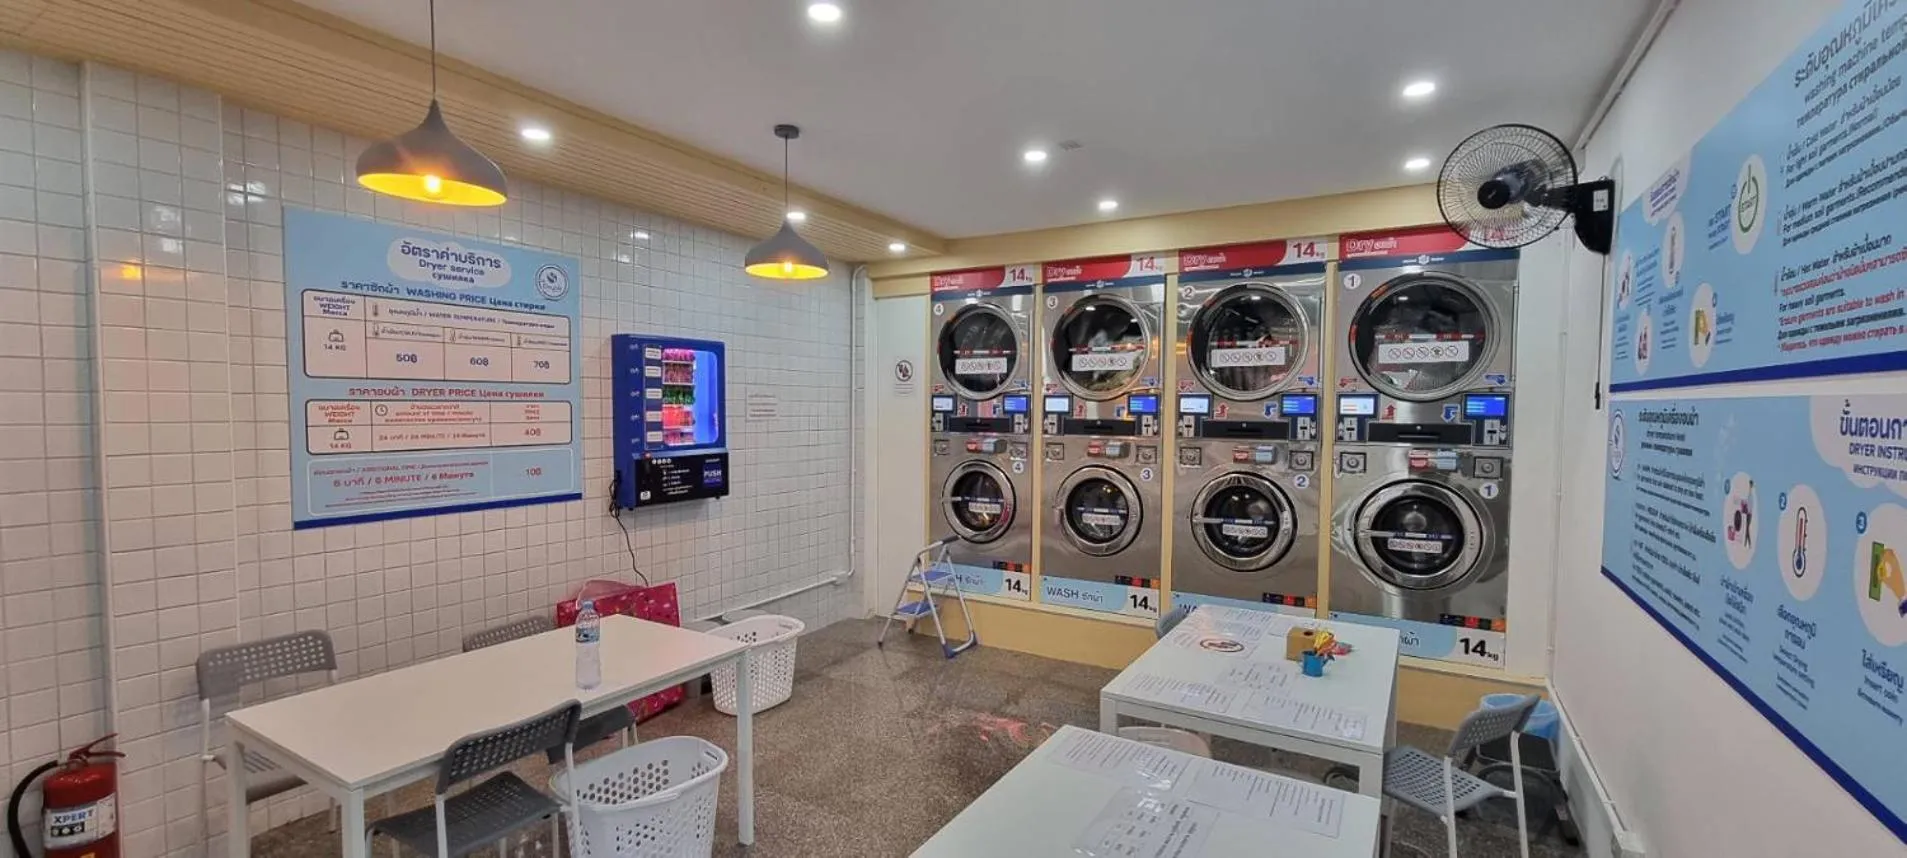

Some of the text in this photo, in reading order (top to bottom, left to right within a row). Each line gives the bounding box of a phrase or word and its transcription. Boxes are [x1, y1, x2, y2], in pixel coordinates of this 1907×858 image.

[400, 240, 502, 269] อัตราค่าบริการ
[419, 258, 485, 276] Dryer service
[406, 287, 457, 301] WASHING
[459, 294, 486, 305] PRICE
[1184, 287, 1193, 297] 2
[1049, 297, 1056, 308] 3
[935, 304, 943, 315] 4
[411, 389, 446, 397] DRYER
[448, 389, 478, 398] PRICE
[1849, 442, 1876, 457] DRYER
[703, 469, 722, 478] PUSH
[1014, 463, 1022, 472] 4
[1142, 469, 1151, 480] 3
[1296, 475, 1306, 488] 2
[1484, 485, 1492, 497] 1
[1047, 586, 1079, 599] WASH
[53, 808, 95, 824] XPERT
